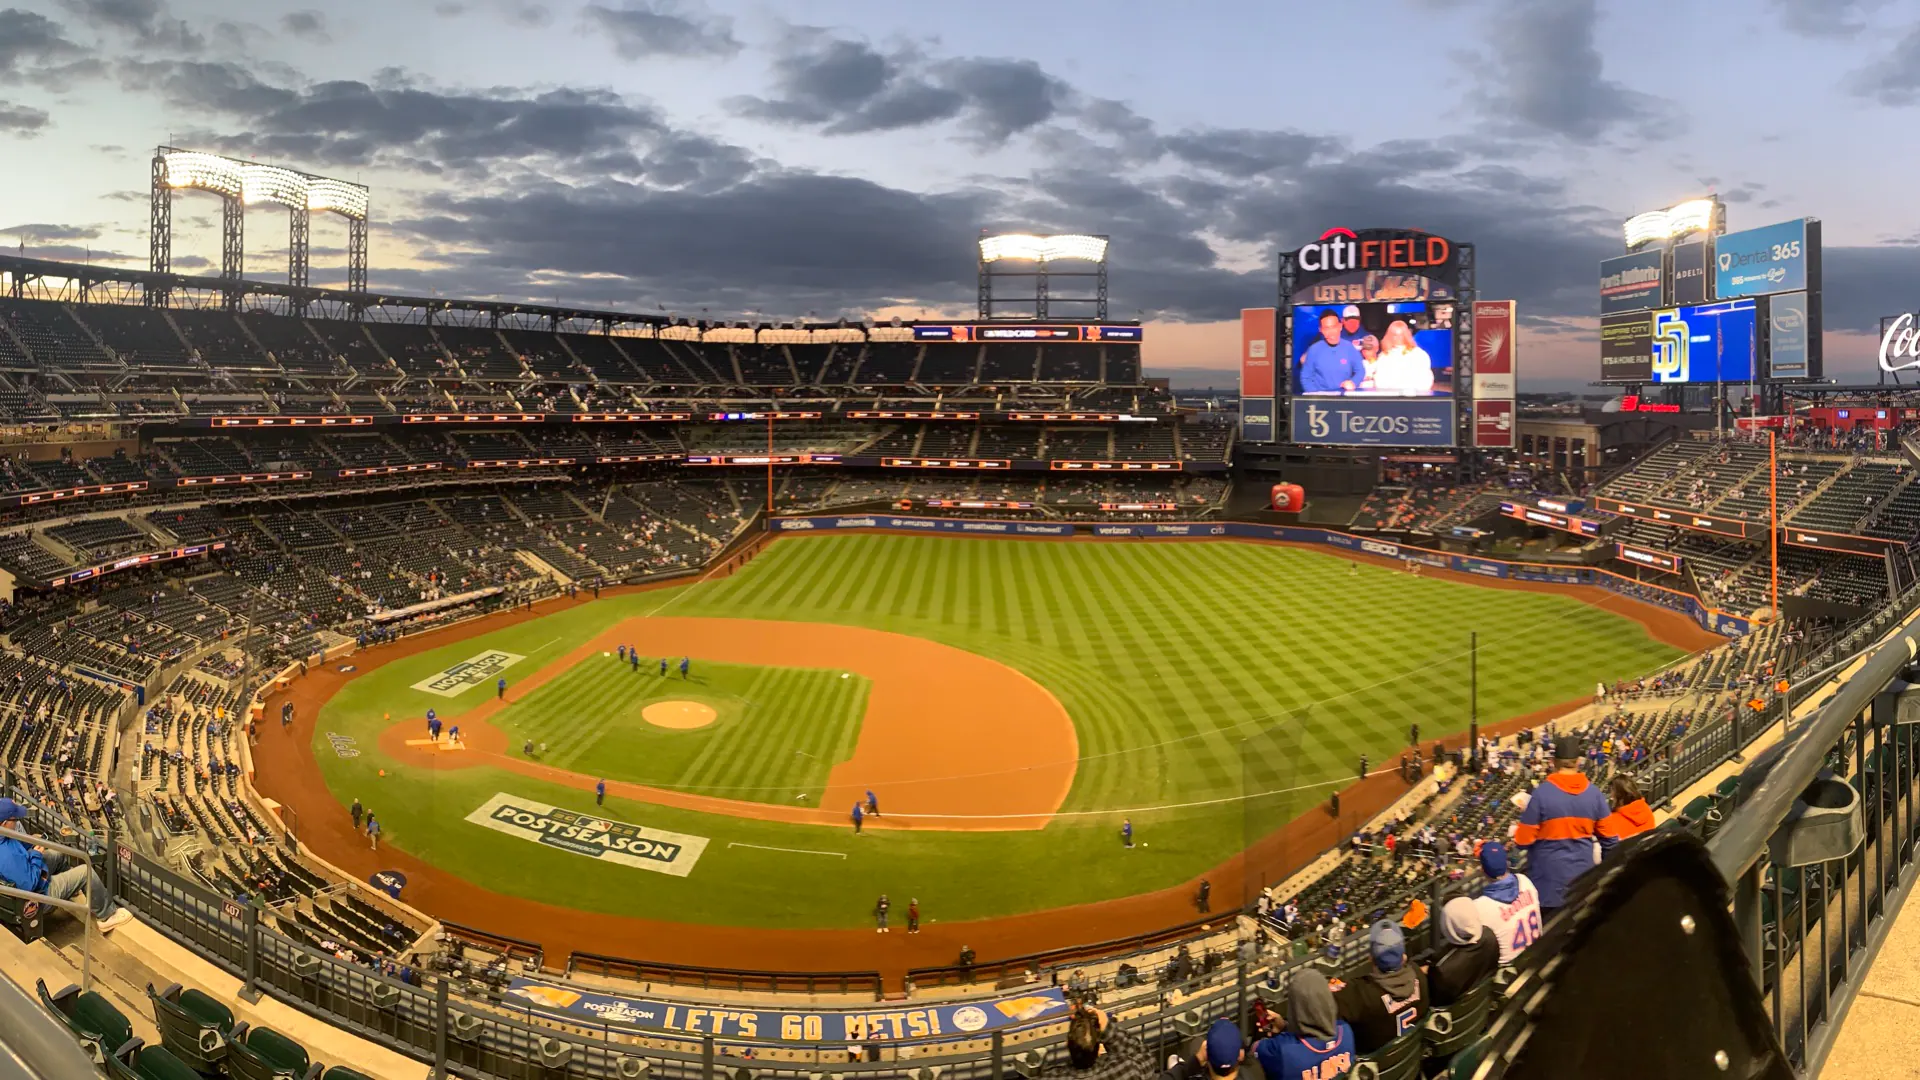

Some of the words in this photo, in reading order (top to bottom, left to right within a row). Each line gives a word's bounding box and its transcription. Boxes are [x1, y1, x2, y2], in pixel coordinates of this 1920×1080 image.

[1299, 235, 1356, 271] citi
[1361, 237, 1449, 268] FIELD
[1335, 410, 1409, 434] Tezos
[1099, 526, 1131, 534] verizon
[1210, 527, 1225, 535] citi
[1361, 541, 1399, 556] GEICO
[498, 807, 676, 860] POSTSEASON
[225, 903, 240, 917] 407
[1511, 910, 1540, 952] 48
[583, 1002, 655, 1019] POSTSEASON
[663, 1006, 758, 1037] LET'S
[781, 1014, 822, 1041] GO
[844, 1009, 941, 1042] METS!
